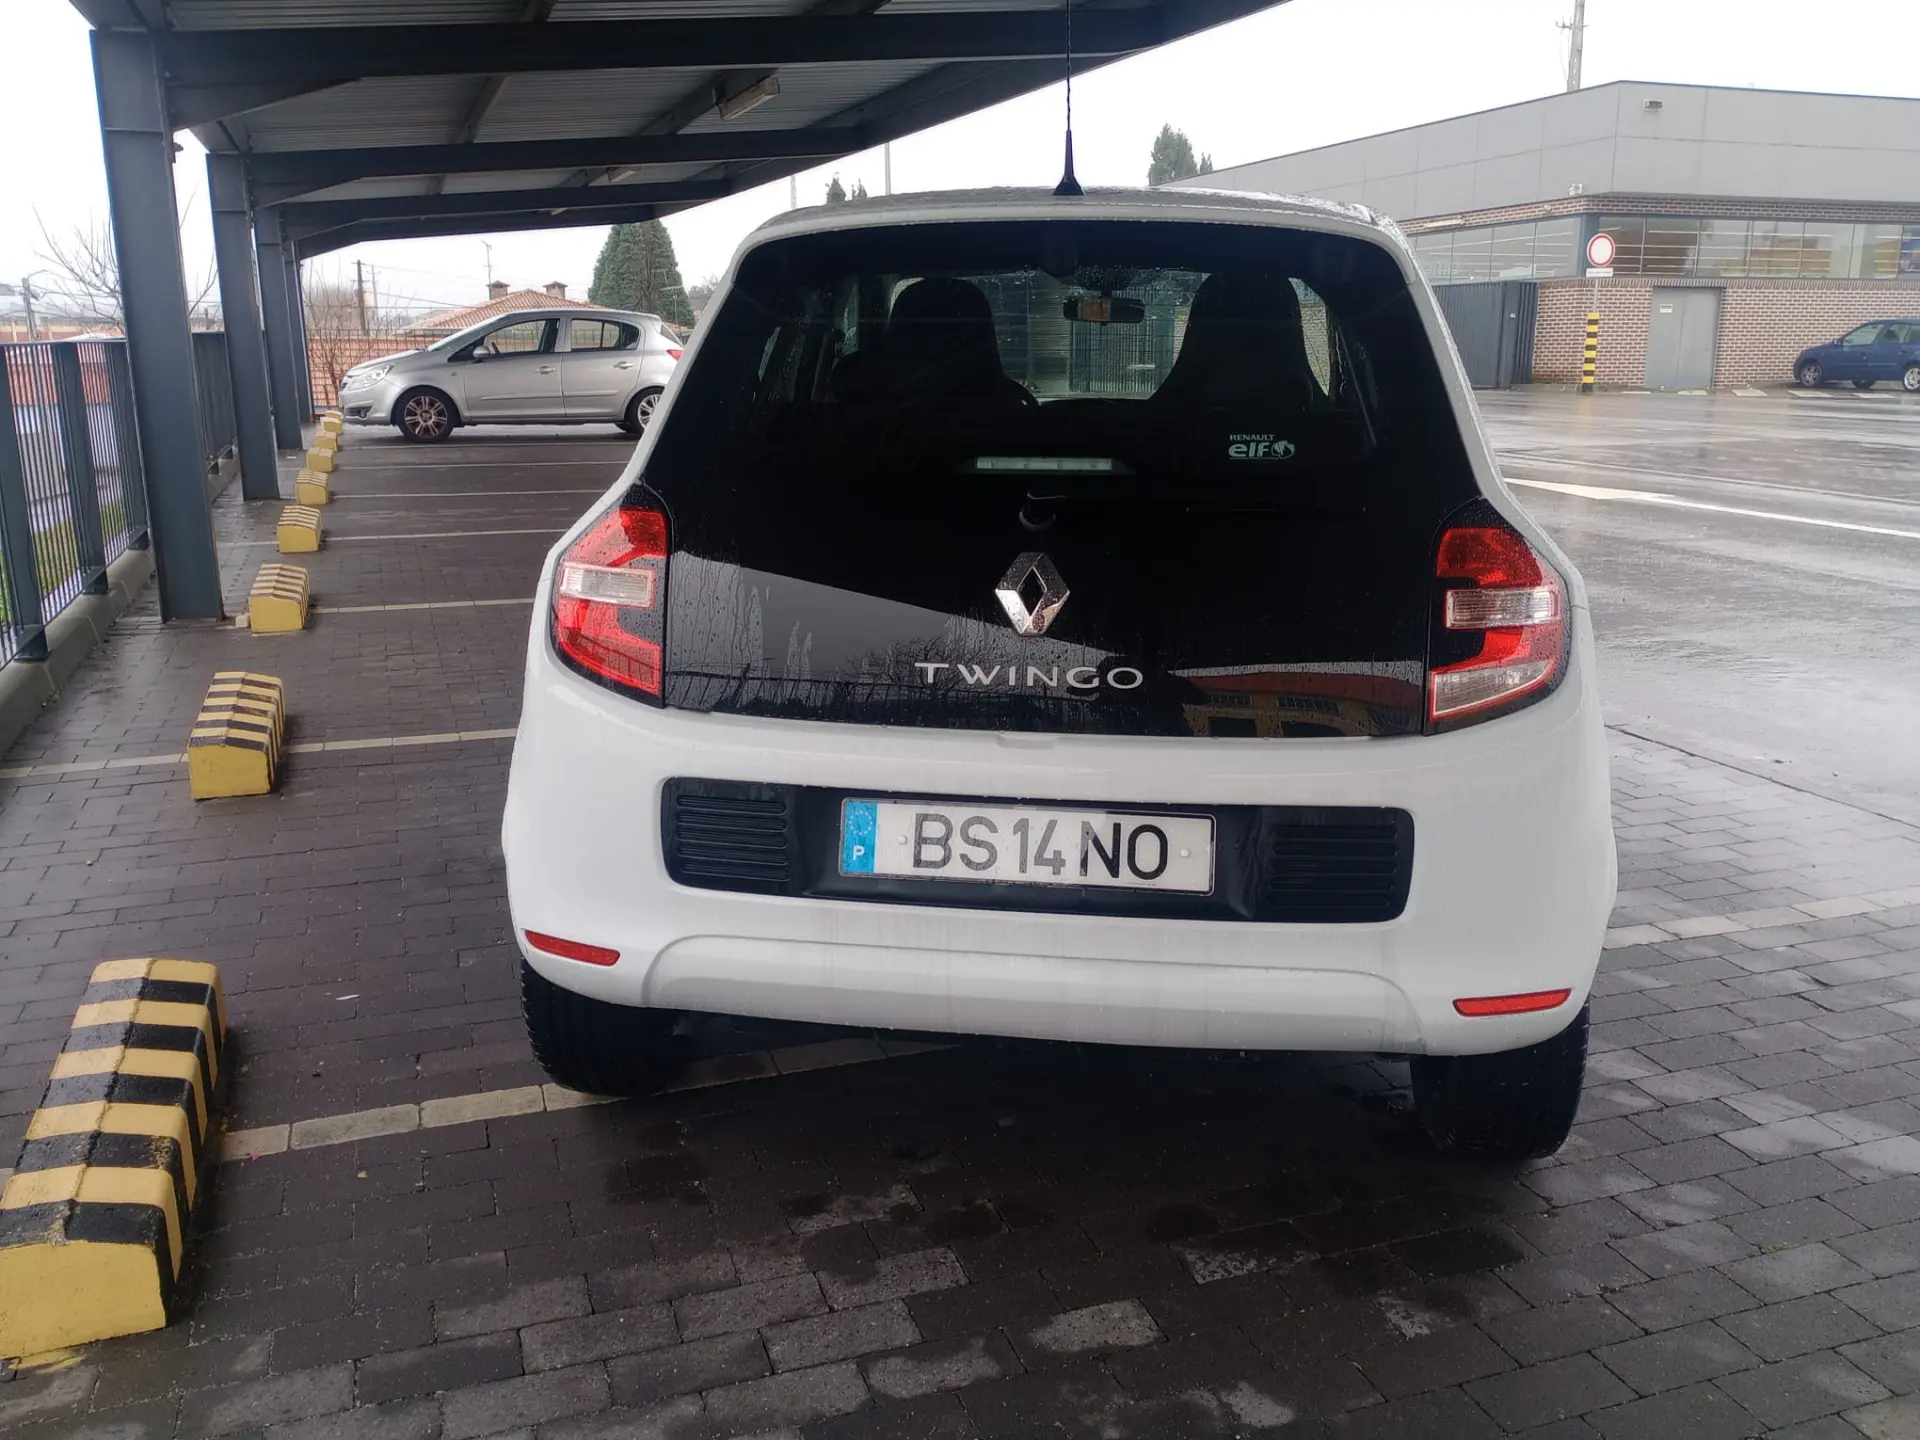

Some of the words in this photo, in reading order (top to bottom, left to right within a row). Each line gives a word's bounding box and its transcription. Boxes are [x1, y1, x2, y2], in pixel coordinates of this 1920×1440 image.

[1228, 442, 1270, 457] elf
[914, 662, 1144, 690] TWINGO
[852, 846, 865, 861] P
[913, 812, 999, 872] BS
[1013, 817, 1066, 876] 14
[1079, 820, 1168, 880] NO
